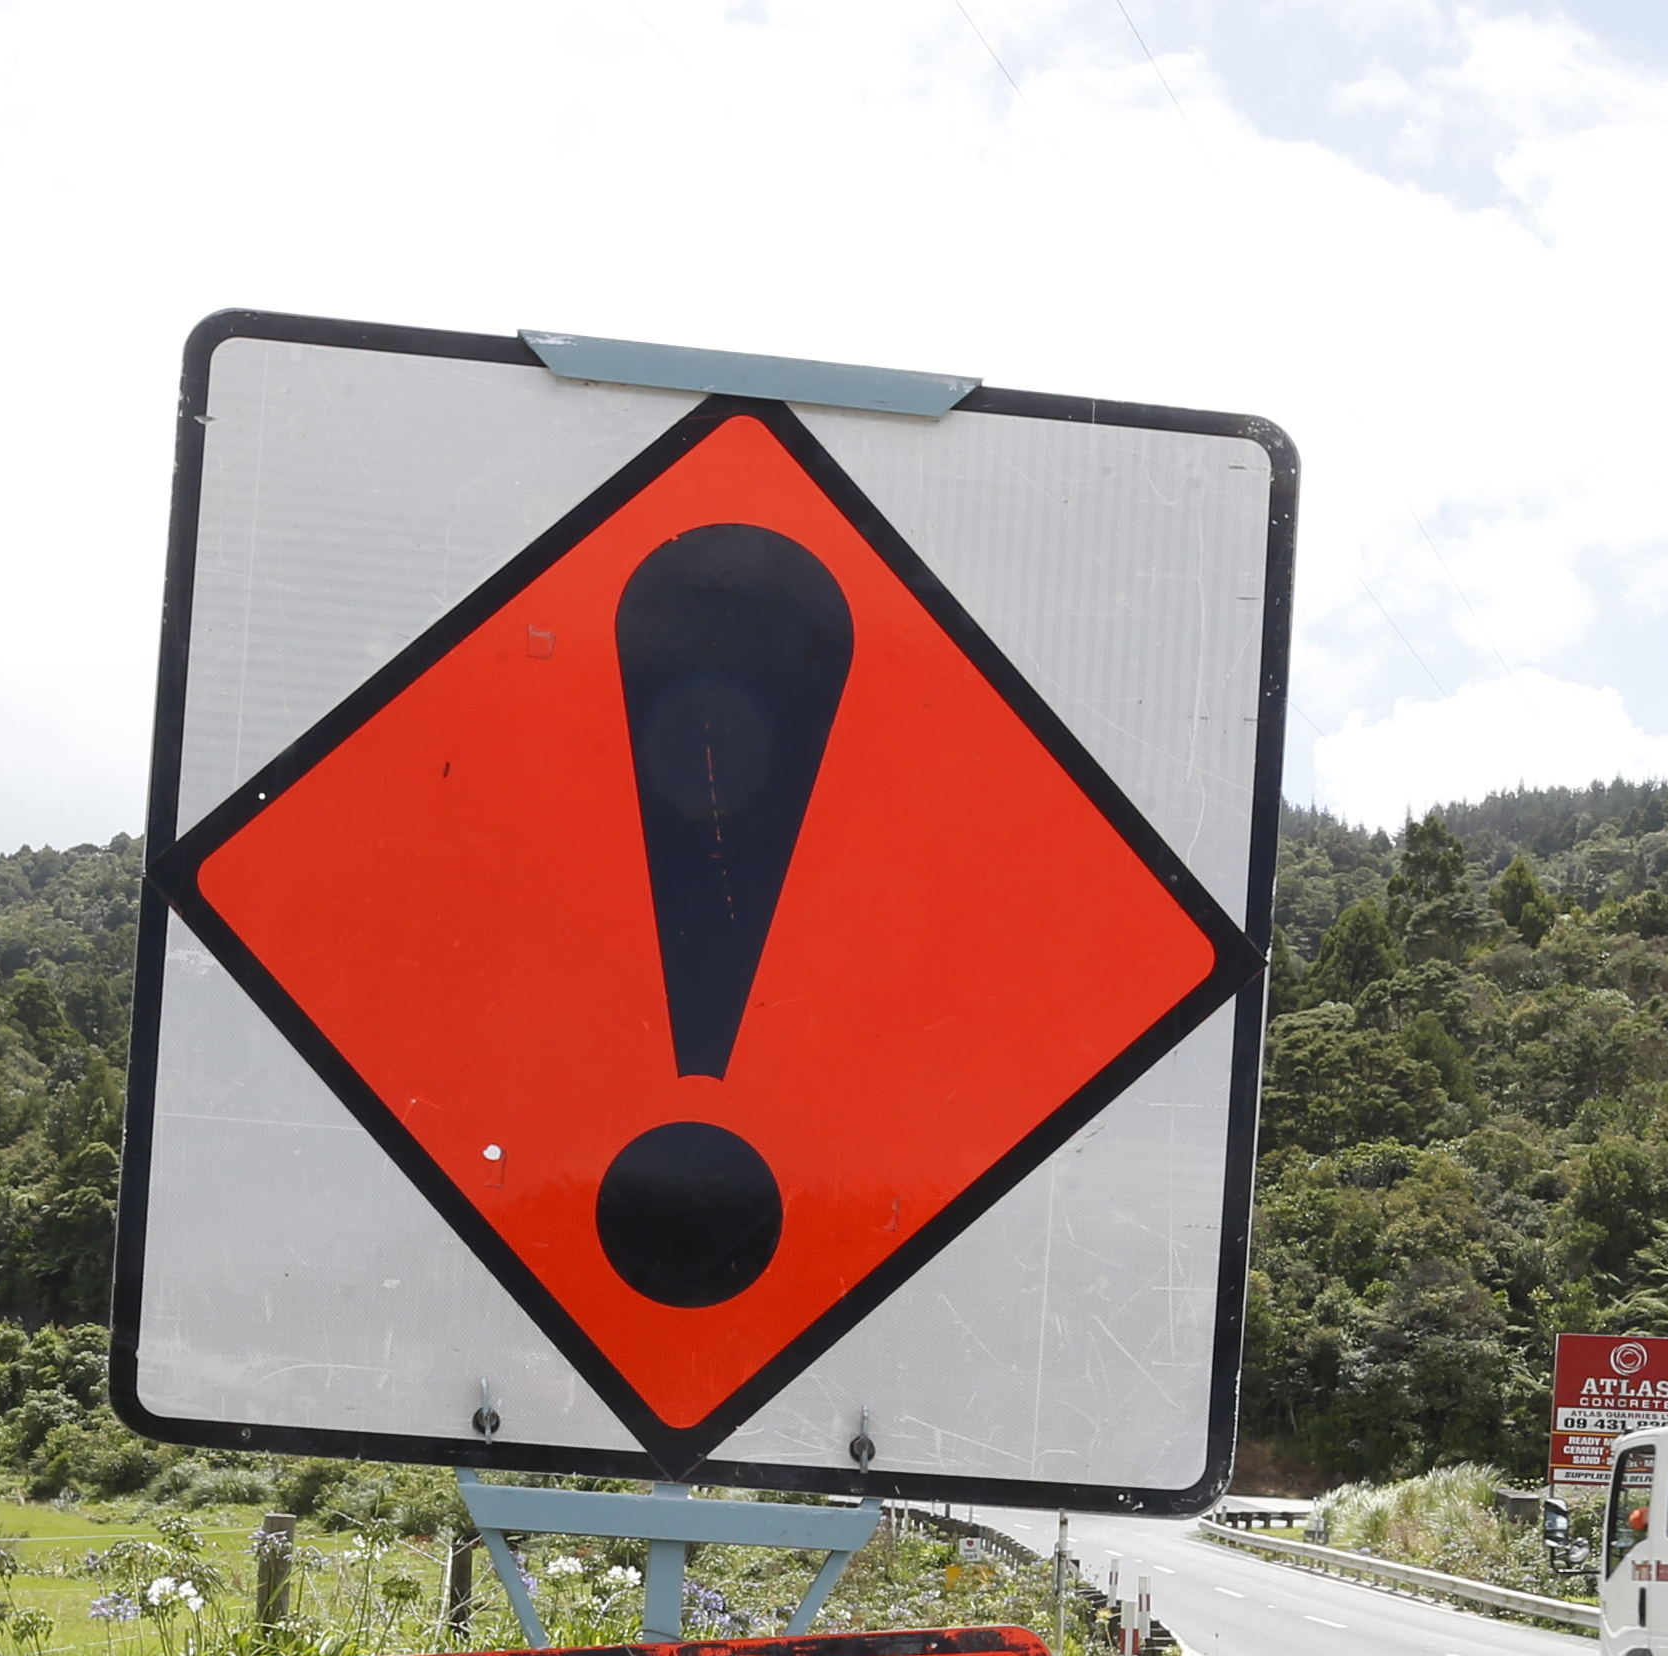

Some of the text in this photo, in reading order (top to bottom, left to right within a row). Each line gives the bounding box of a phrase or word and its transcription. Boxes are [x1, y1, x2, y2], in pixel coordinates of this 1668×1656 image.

[1571, 1410, 1602, 1418] ATLAS
[1605, 1411, 1658, 1420] QUARRIES
[1564, 1417, 1587, 1429] 09
[1594, 1418, 1626, 1430] 431
[1568, 1436, 1601, 1446] READY
[1563, 1445, 1604, 1455] CEMENT
[1572, 1456, 1600, 1465] SAND
[1564, 1471, 1611, 1480] SUPPLIED
